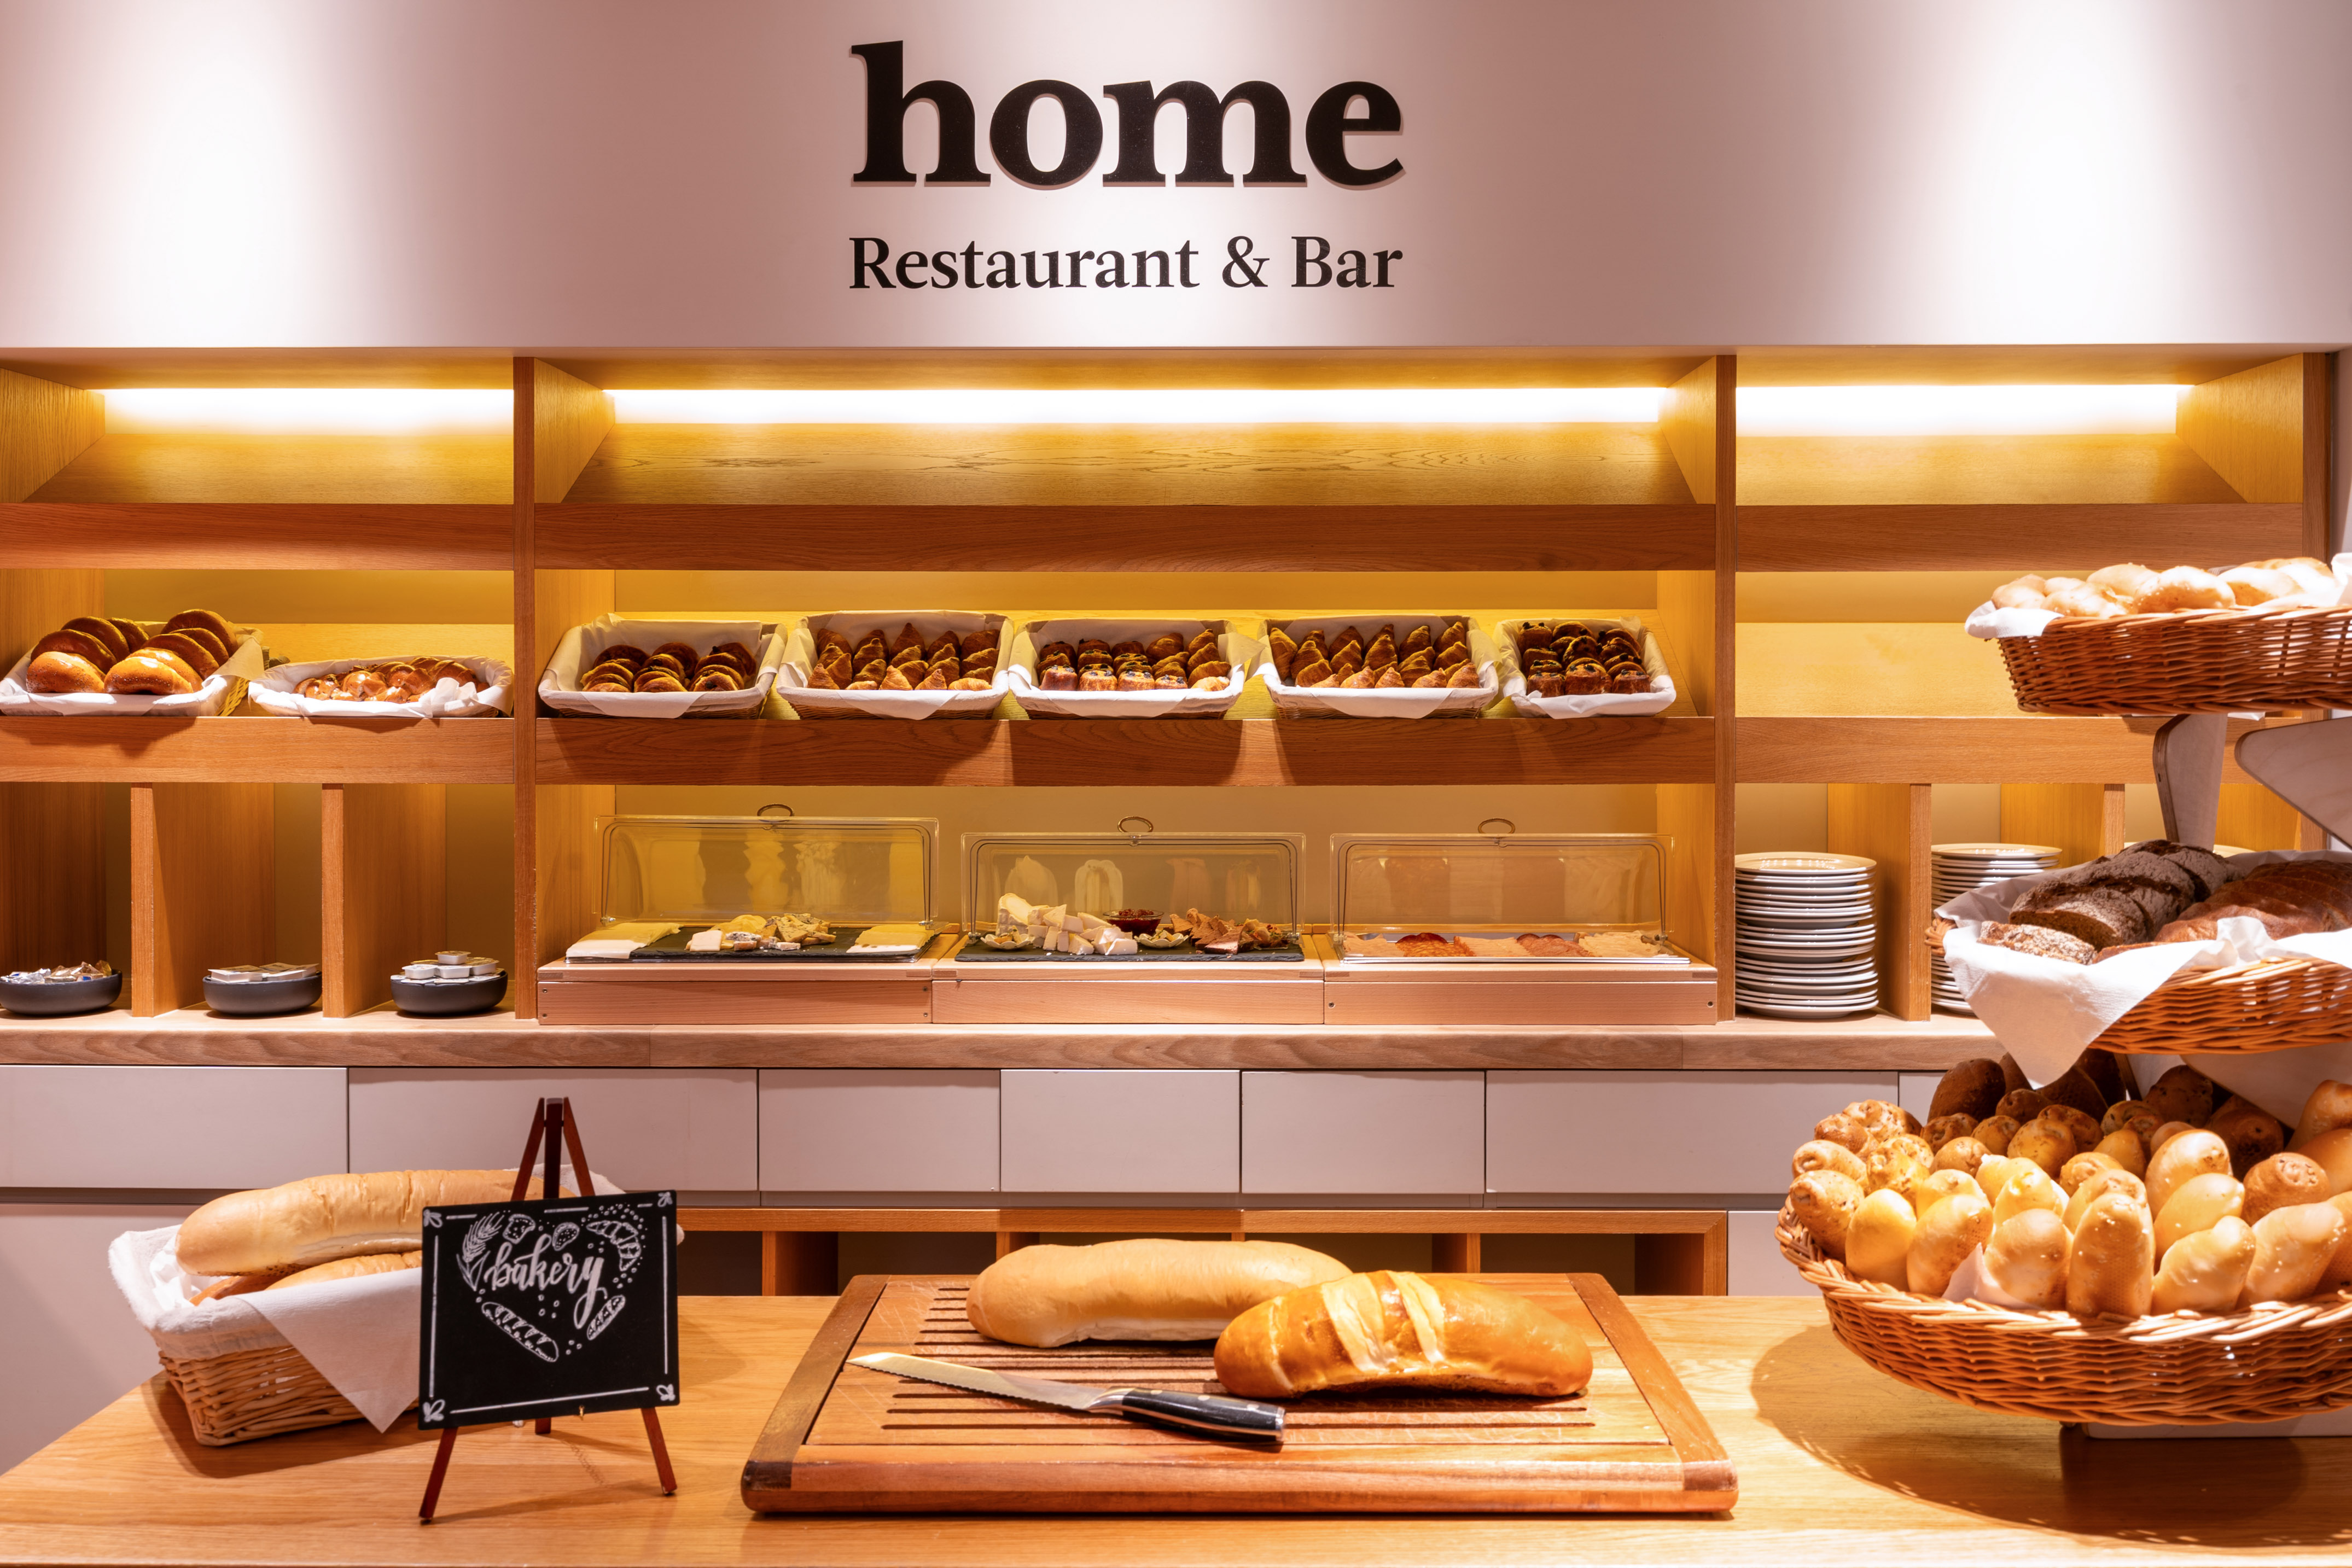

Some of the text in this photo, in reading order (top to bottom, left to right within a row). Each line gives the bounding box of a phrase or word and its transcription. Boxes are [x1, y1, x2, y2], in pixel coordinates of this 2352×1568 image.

[851, 40, 1405, 186] home
[849, 236, 1403, 289] Restaurant & Bar
[484, 1234, 608, 1330] bakery
